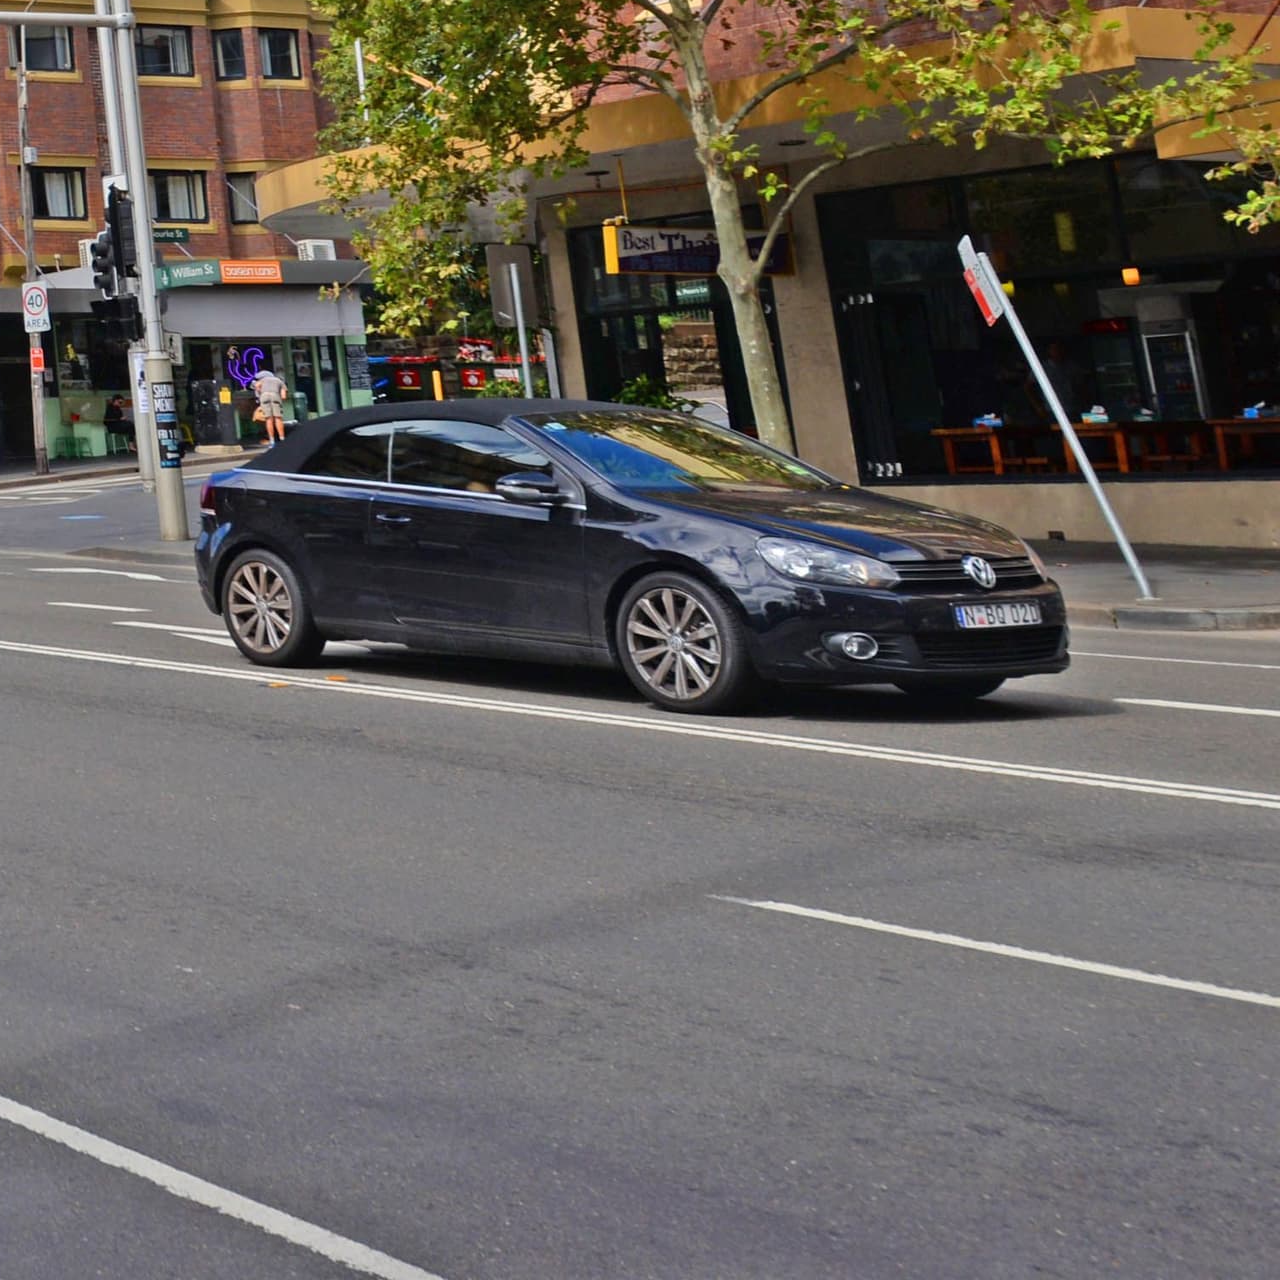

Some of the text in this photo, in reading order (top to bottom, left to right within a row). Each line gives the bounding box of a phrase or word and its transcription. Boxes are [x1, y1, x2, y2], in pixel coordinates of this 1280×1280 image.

[622, 230, 655, 251] Best
[171, 264, 214, 279] William St
[27, 294, 43, 308] 40
[26, 318, 49, 328] AREA
